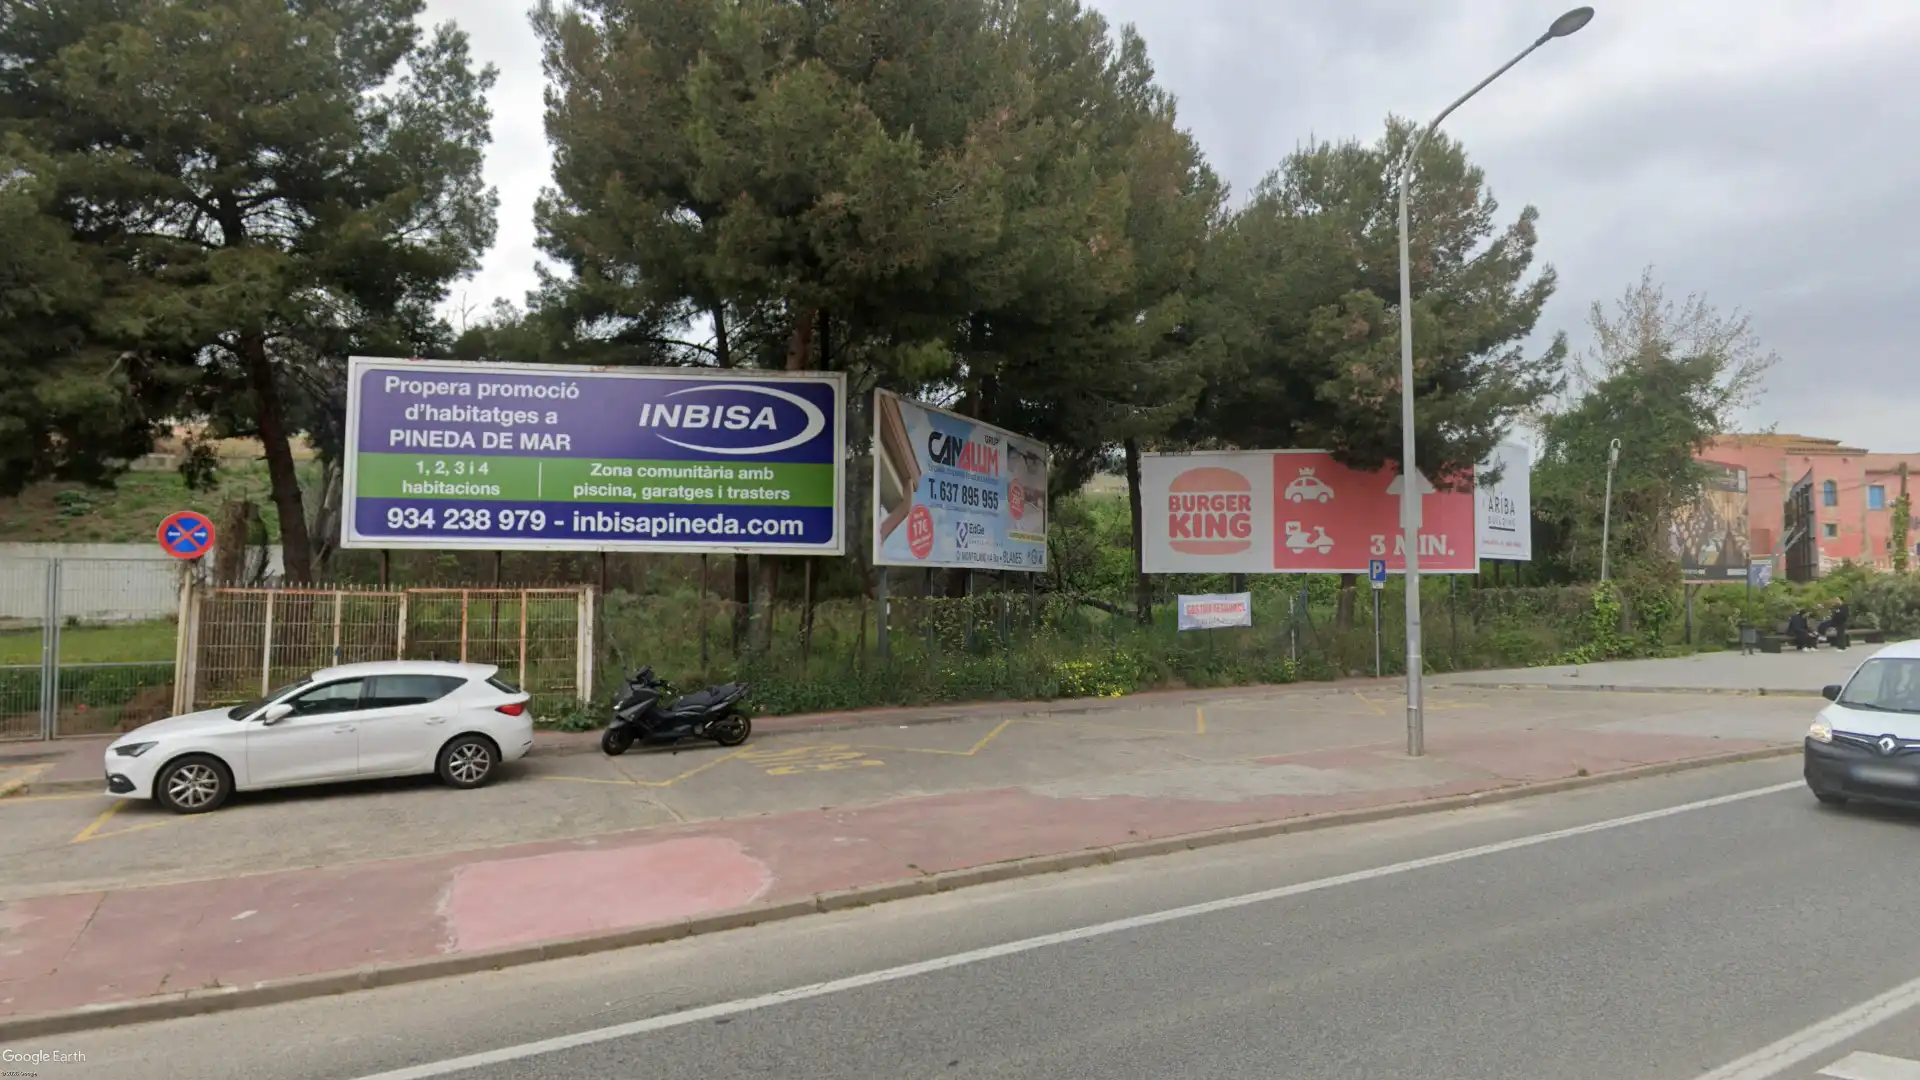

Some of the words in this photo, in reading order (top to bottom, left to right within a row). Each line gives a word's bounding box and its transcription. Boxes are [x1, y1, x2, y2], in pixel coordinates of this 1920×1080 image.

[385, 375, 471, 398] Propera
[477, 380, 580, 400] promoció
[545, 411, 559, 425] a
[638, 402, 778, 431] INBISA
[389, 429, 476, 449] PINEDA
[482, 431, 514, 450] DE
[520, 433, 572, 451] MAR
[415, 460, 430, 476] 1,
[435, 460, 450, 477] 2,
[454, 460, 465, 475] 3
[469, 461, 475, 475] i
[478, 461, 490, 475] 4
[590, 462, 633, 477] Zona
[637, 464, 734, 480] comunitària
[738, 466, 775, 481] amb
[401, 479, 501, 496] habitacions
[573, 482, 637, 500] piscina,
[641, 486, 714, 502] garatges
[718, 486, 723, 499] i
[727, 486, 791, 501] trasters
[928, 477, 937, 500] T.
[939, 480, 959, 503] 637
[961, 484, 980, 507] 895
[981, 489, 999, 510] 955
[1168, 494, 1252, 513] BURGER
[387, 506, 436, 530] 934
[442, 508, 492, 531] 238
[498, 509, 547, 532] 979
[572, 510, 804, 537] inbisapineda.com
[1168, 513, 1252, 539] KING
[1370, 534, 1386, 556] 3
[1372, 561, 1383, 579] P
